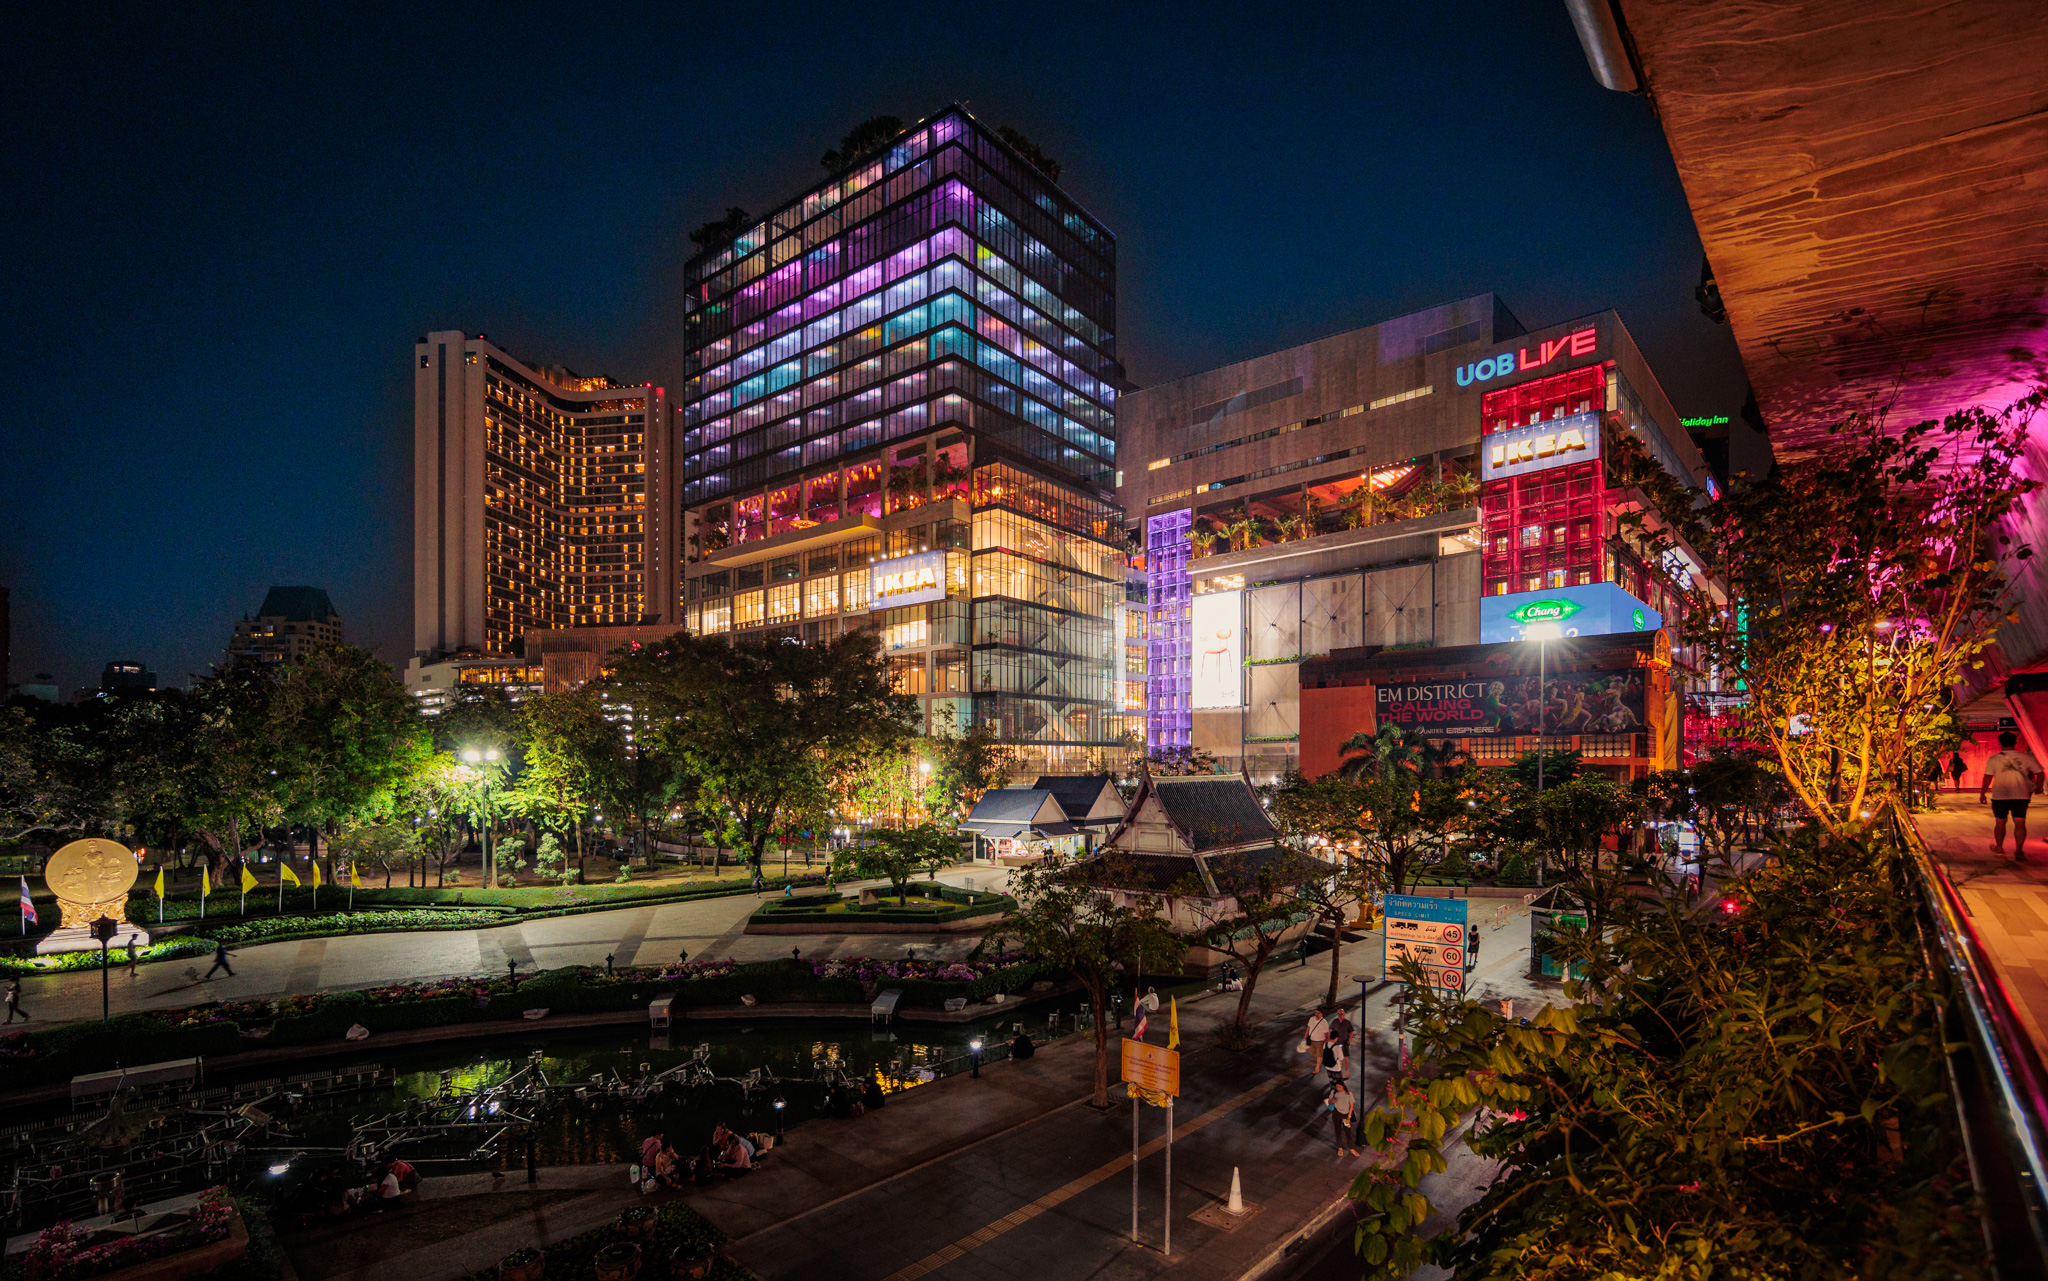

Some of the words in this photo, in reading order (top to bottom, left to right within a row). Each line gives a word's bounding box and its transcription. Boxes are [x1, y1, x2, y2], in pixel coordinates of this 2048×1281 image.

[1456, 353, 1515, 387] UOB
[1519, 328, 1596, 370] LIVE
[1713, 415, 1729, 424] Inn
[1492, 429, 1586, 468] IKEA
[875, 567, 936, 596] IKEA
[1527, 606, 1560, 617] Chang
[1378, 688, 1402, 702] EM
[1407, 683, 1487, 701] DISTRICT
[1389, 699, 1471, 713] CALLING
[1378, 712, 1412, 722] THE
[1416, 710, 1484, 722] WORLD
[1389, 897, 1438, 910] จำกัดความเร็ว
[1446, 930, 1458, 938] 45
[1446, 952, 1458, 960] 60
[1446, 974, 1458, 983] 80
